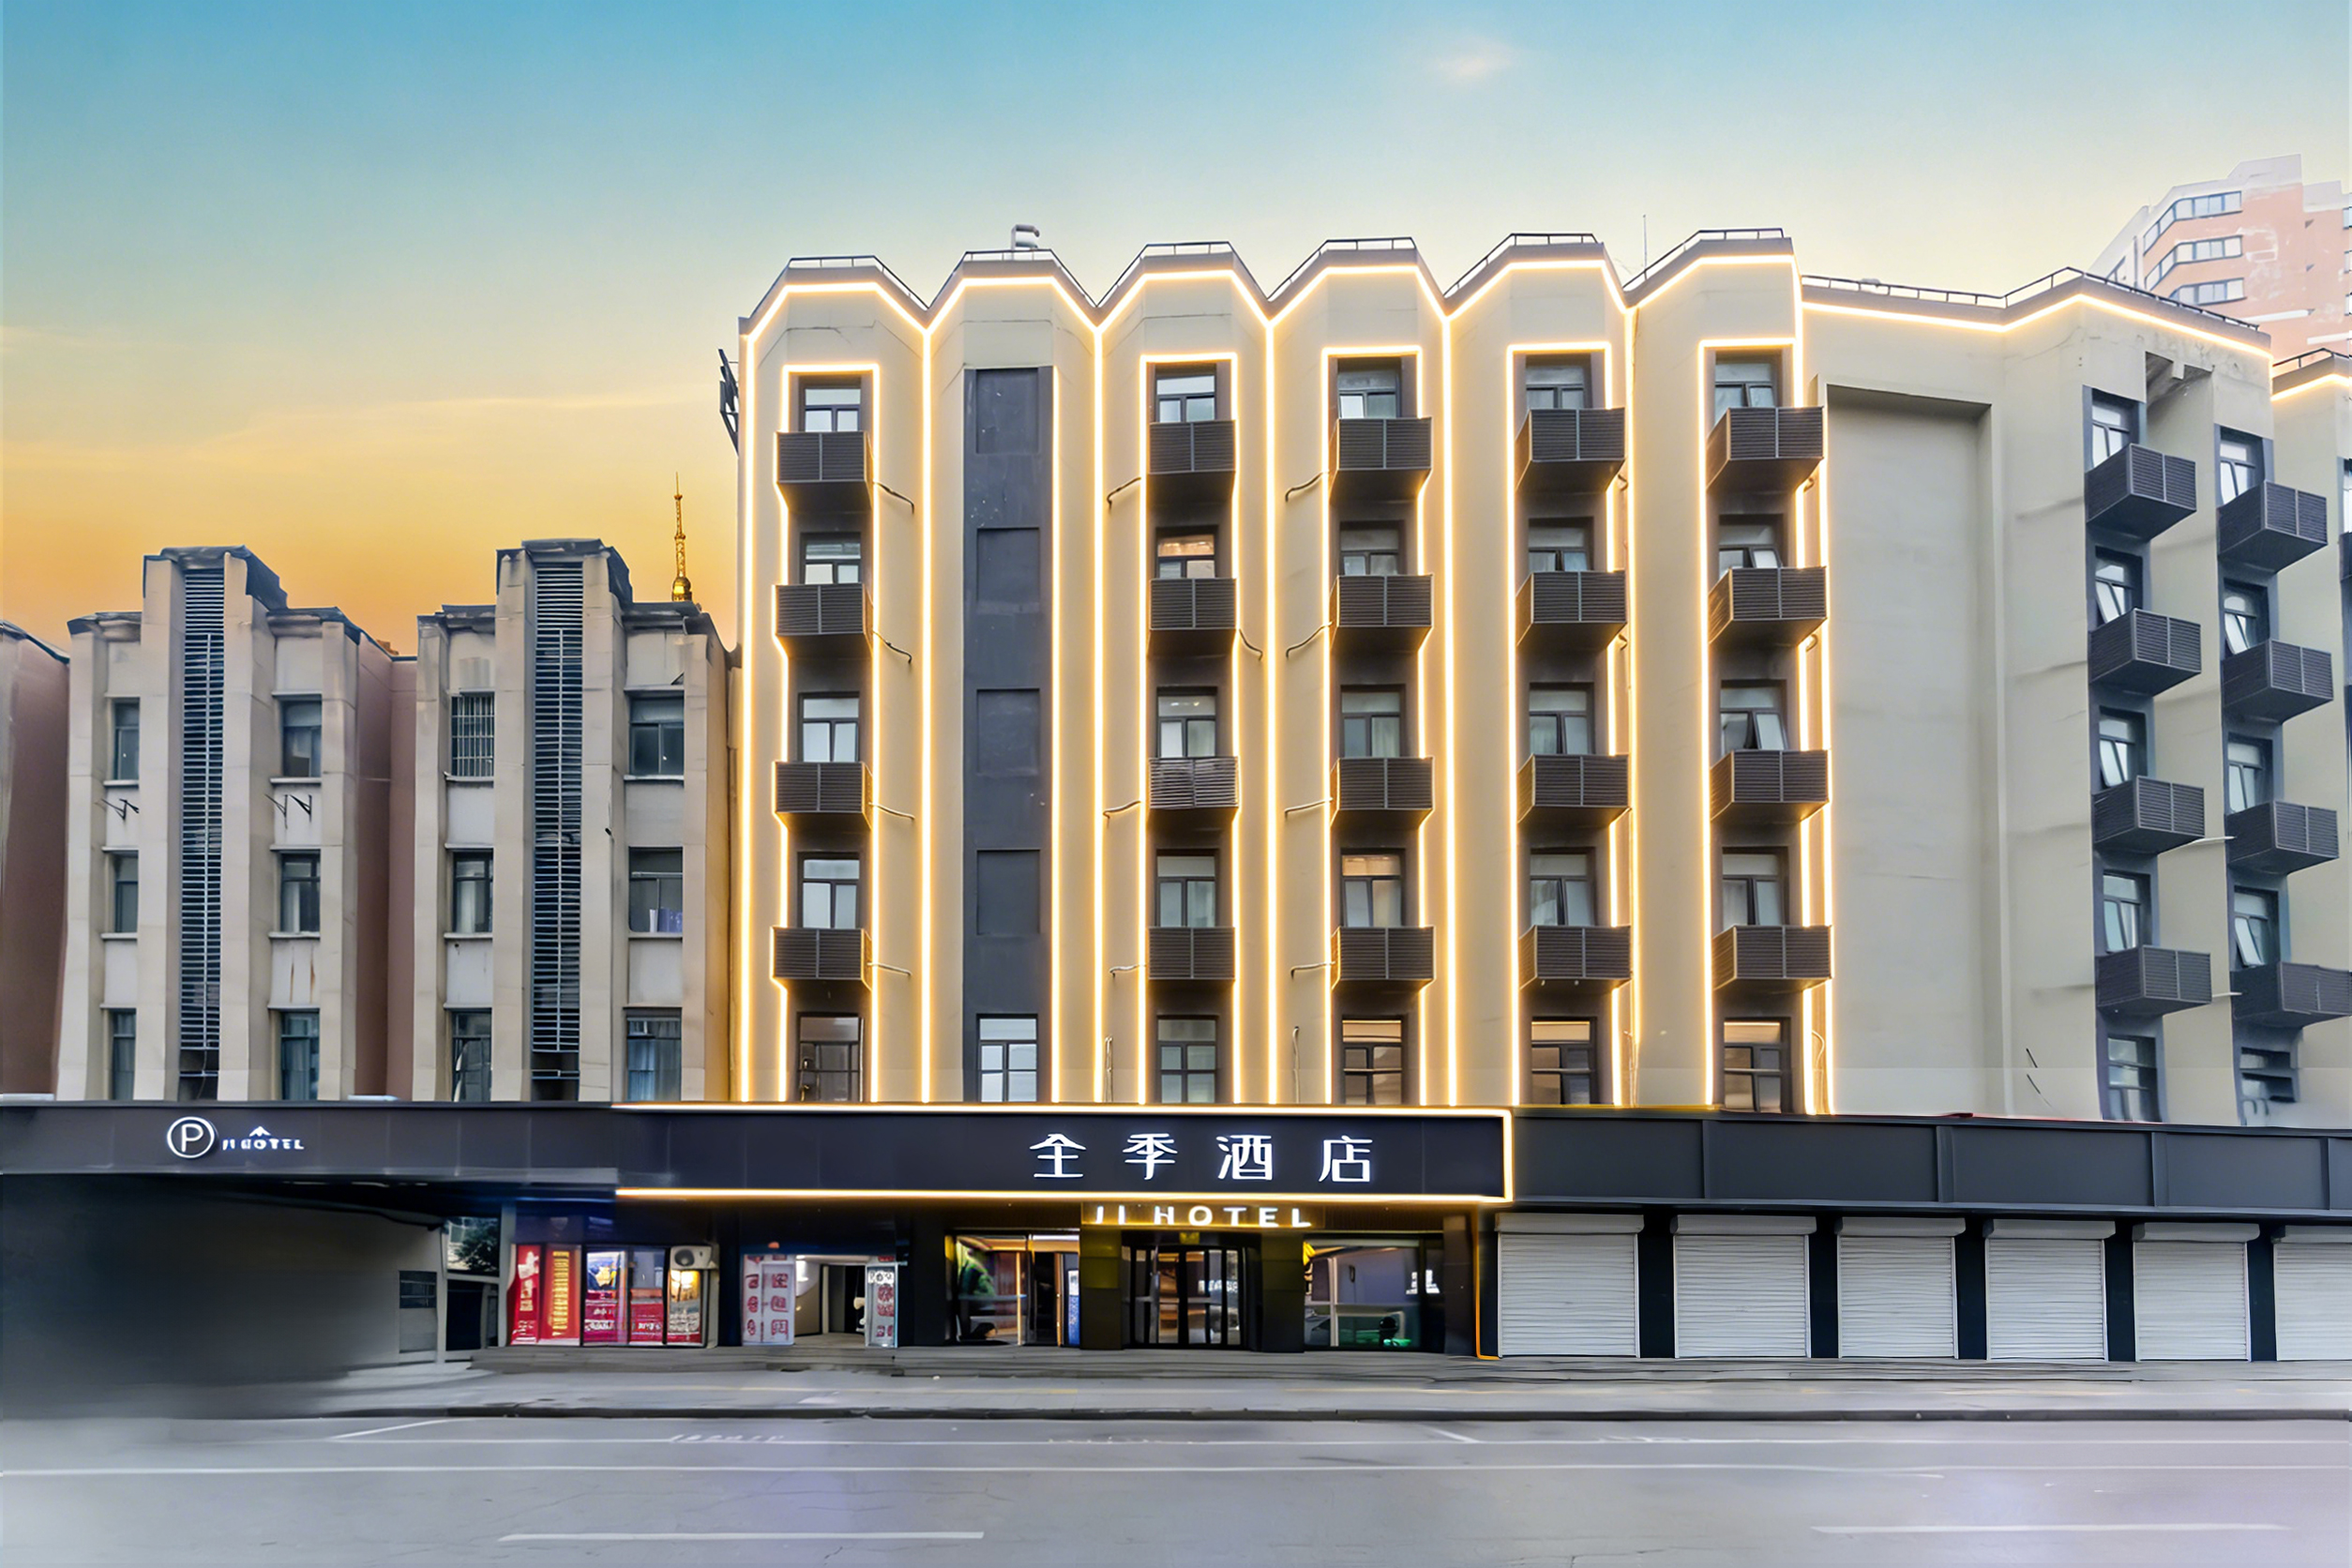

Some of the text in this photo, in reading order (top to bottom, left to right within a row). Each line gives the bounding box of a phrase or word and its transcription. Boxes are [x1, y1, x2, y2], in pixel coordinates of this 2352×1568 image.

[181, 1123, 204, 1153] P
[1029, 1133, 1373, 1183] 全季酒店
[1153, 1205, 1312, 1228] HOTEL
